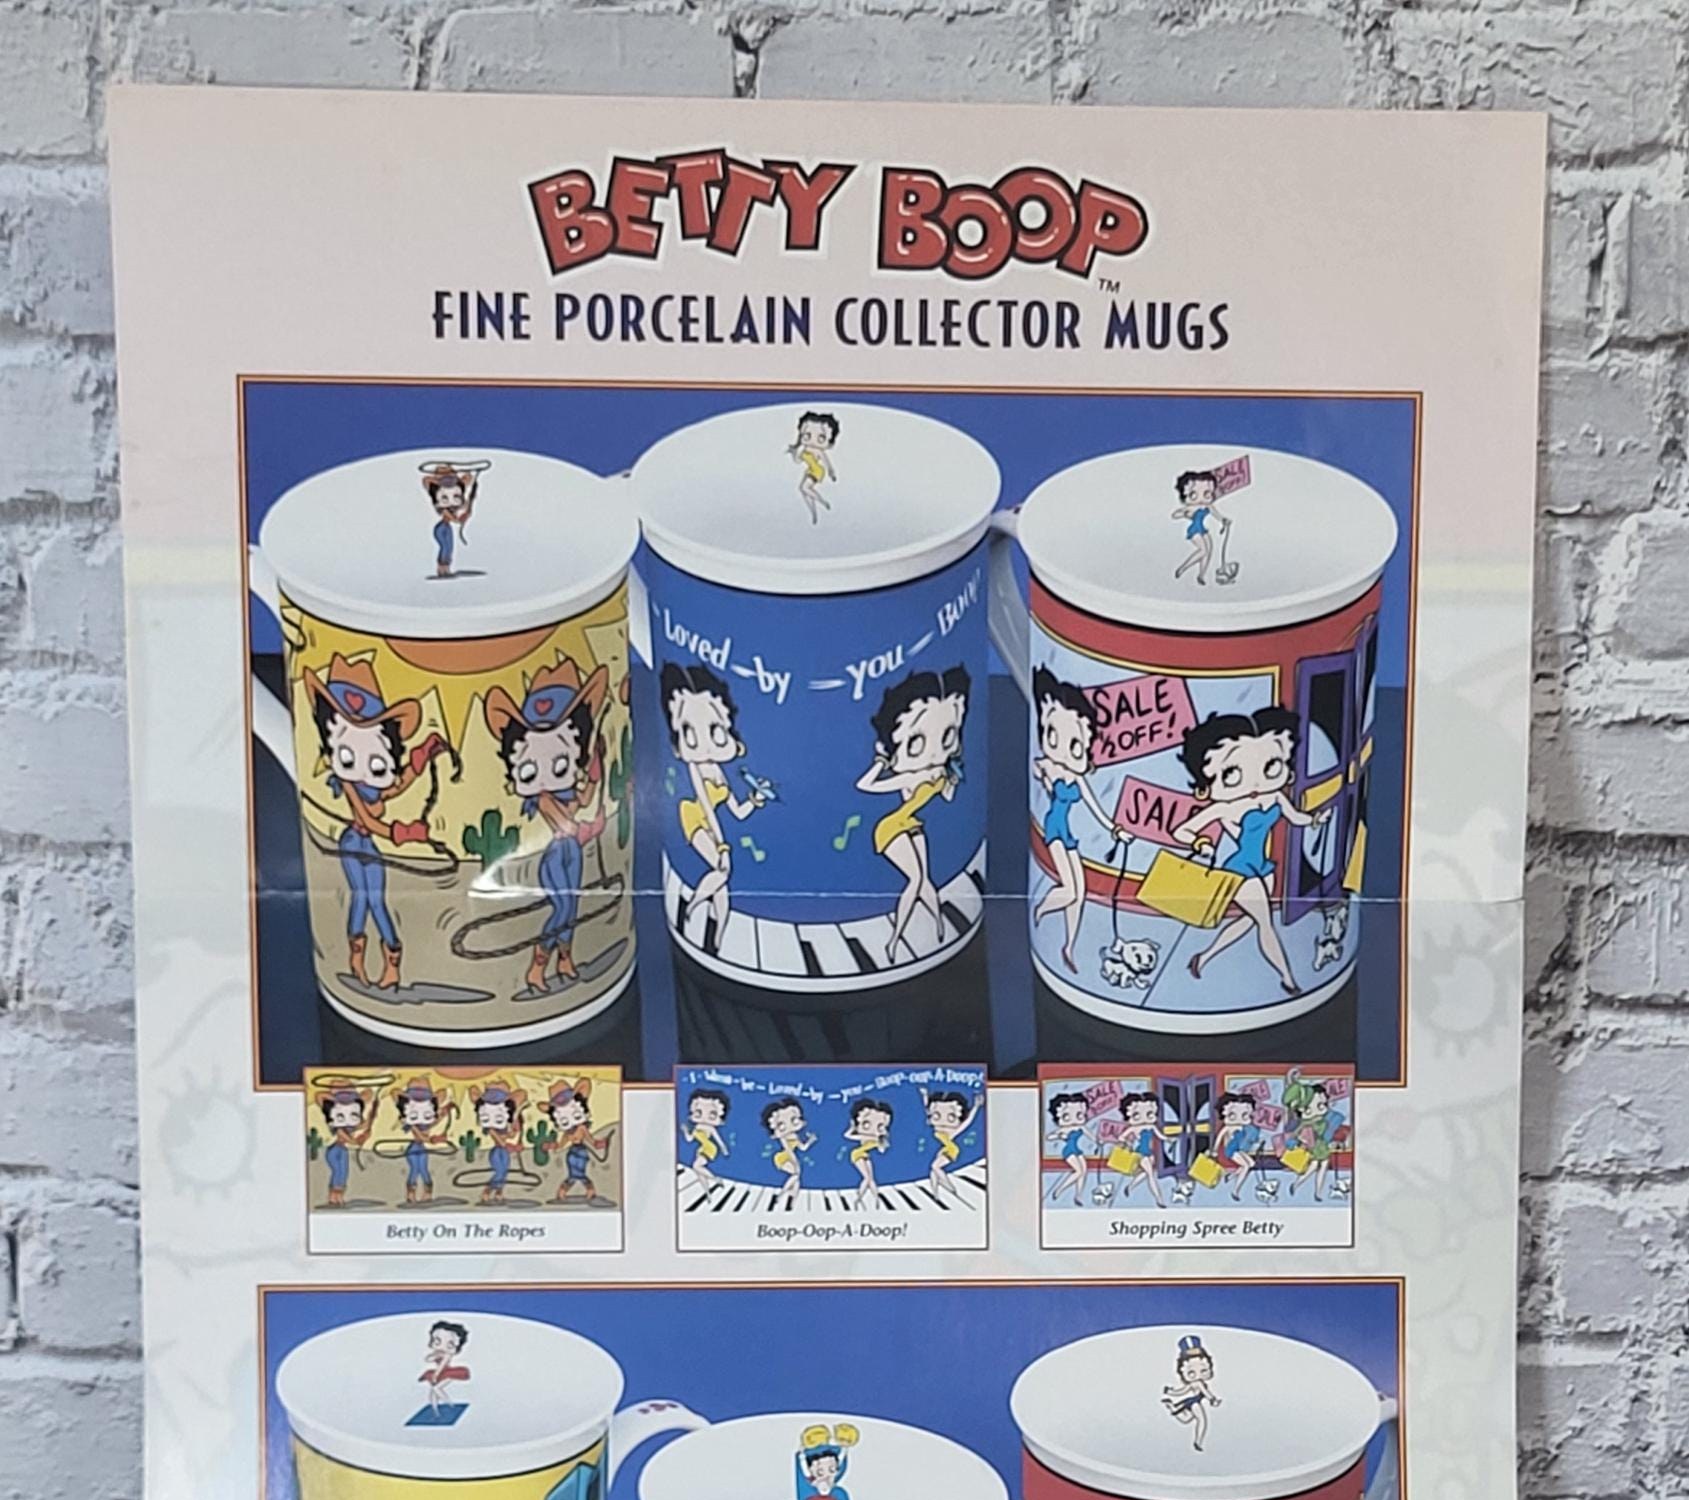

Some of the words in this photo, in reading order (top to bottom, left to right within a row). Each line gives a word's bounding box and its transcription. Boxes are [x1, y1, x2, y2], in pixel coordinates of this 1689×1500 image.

[528, 148, 857, 276] BETTY
[877, 166, 1149, 280] BOOP
[432, 290, 532, 344] FINE
[554, 292, 811, 349] PORCELAIN
[834, 297, 1081, 351] COLLECTOR
[1104, 299, 1231, 352] MUGS
[1092, 679, 1173, 728] SALE
[385, 1223, 428, 1242] Betty
[432, 1224, 457, 1239] On
[464, 1223, 494, 1239] The
[498, 1223, 546, 1242] Ropes
[1108, 1220, 1187, 1239] Shopping
[1191, 1220, 1237, 1239] Spree
[1242, 1220, 1285, 1239] Betty
